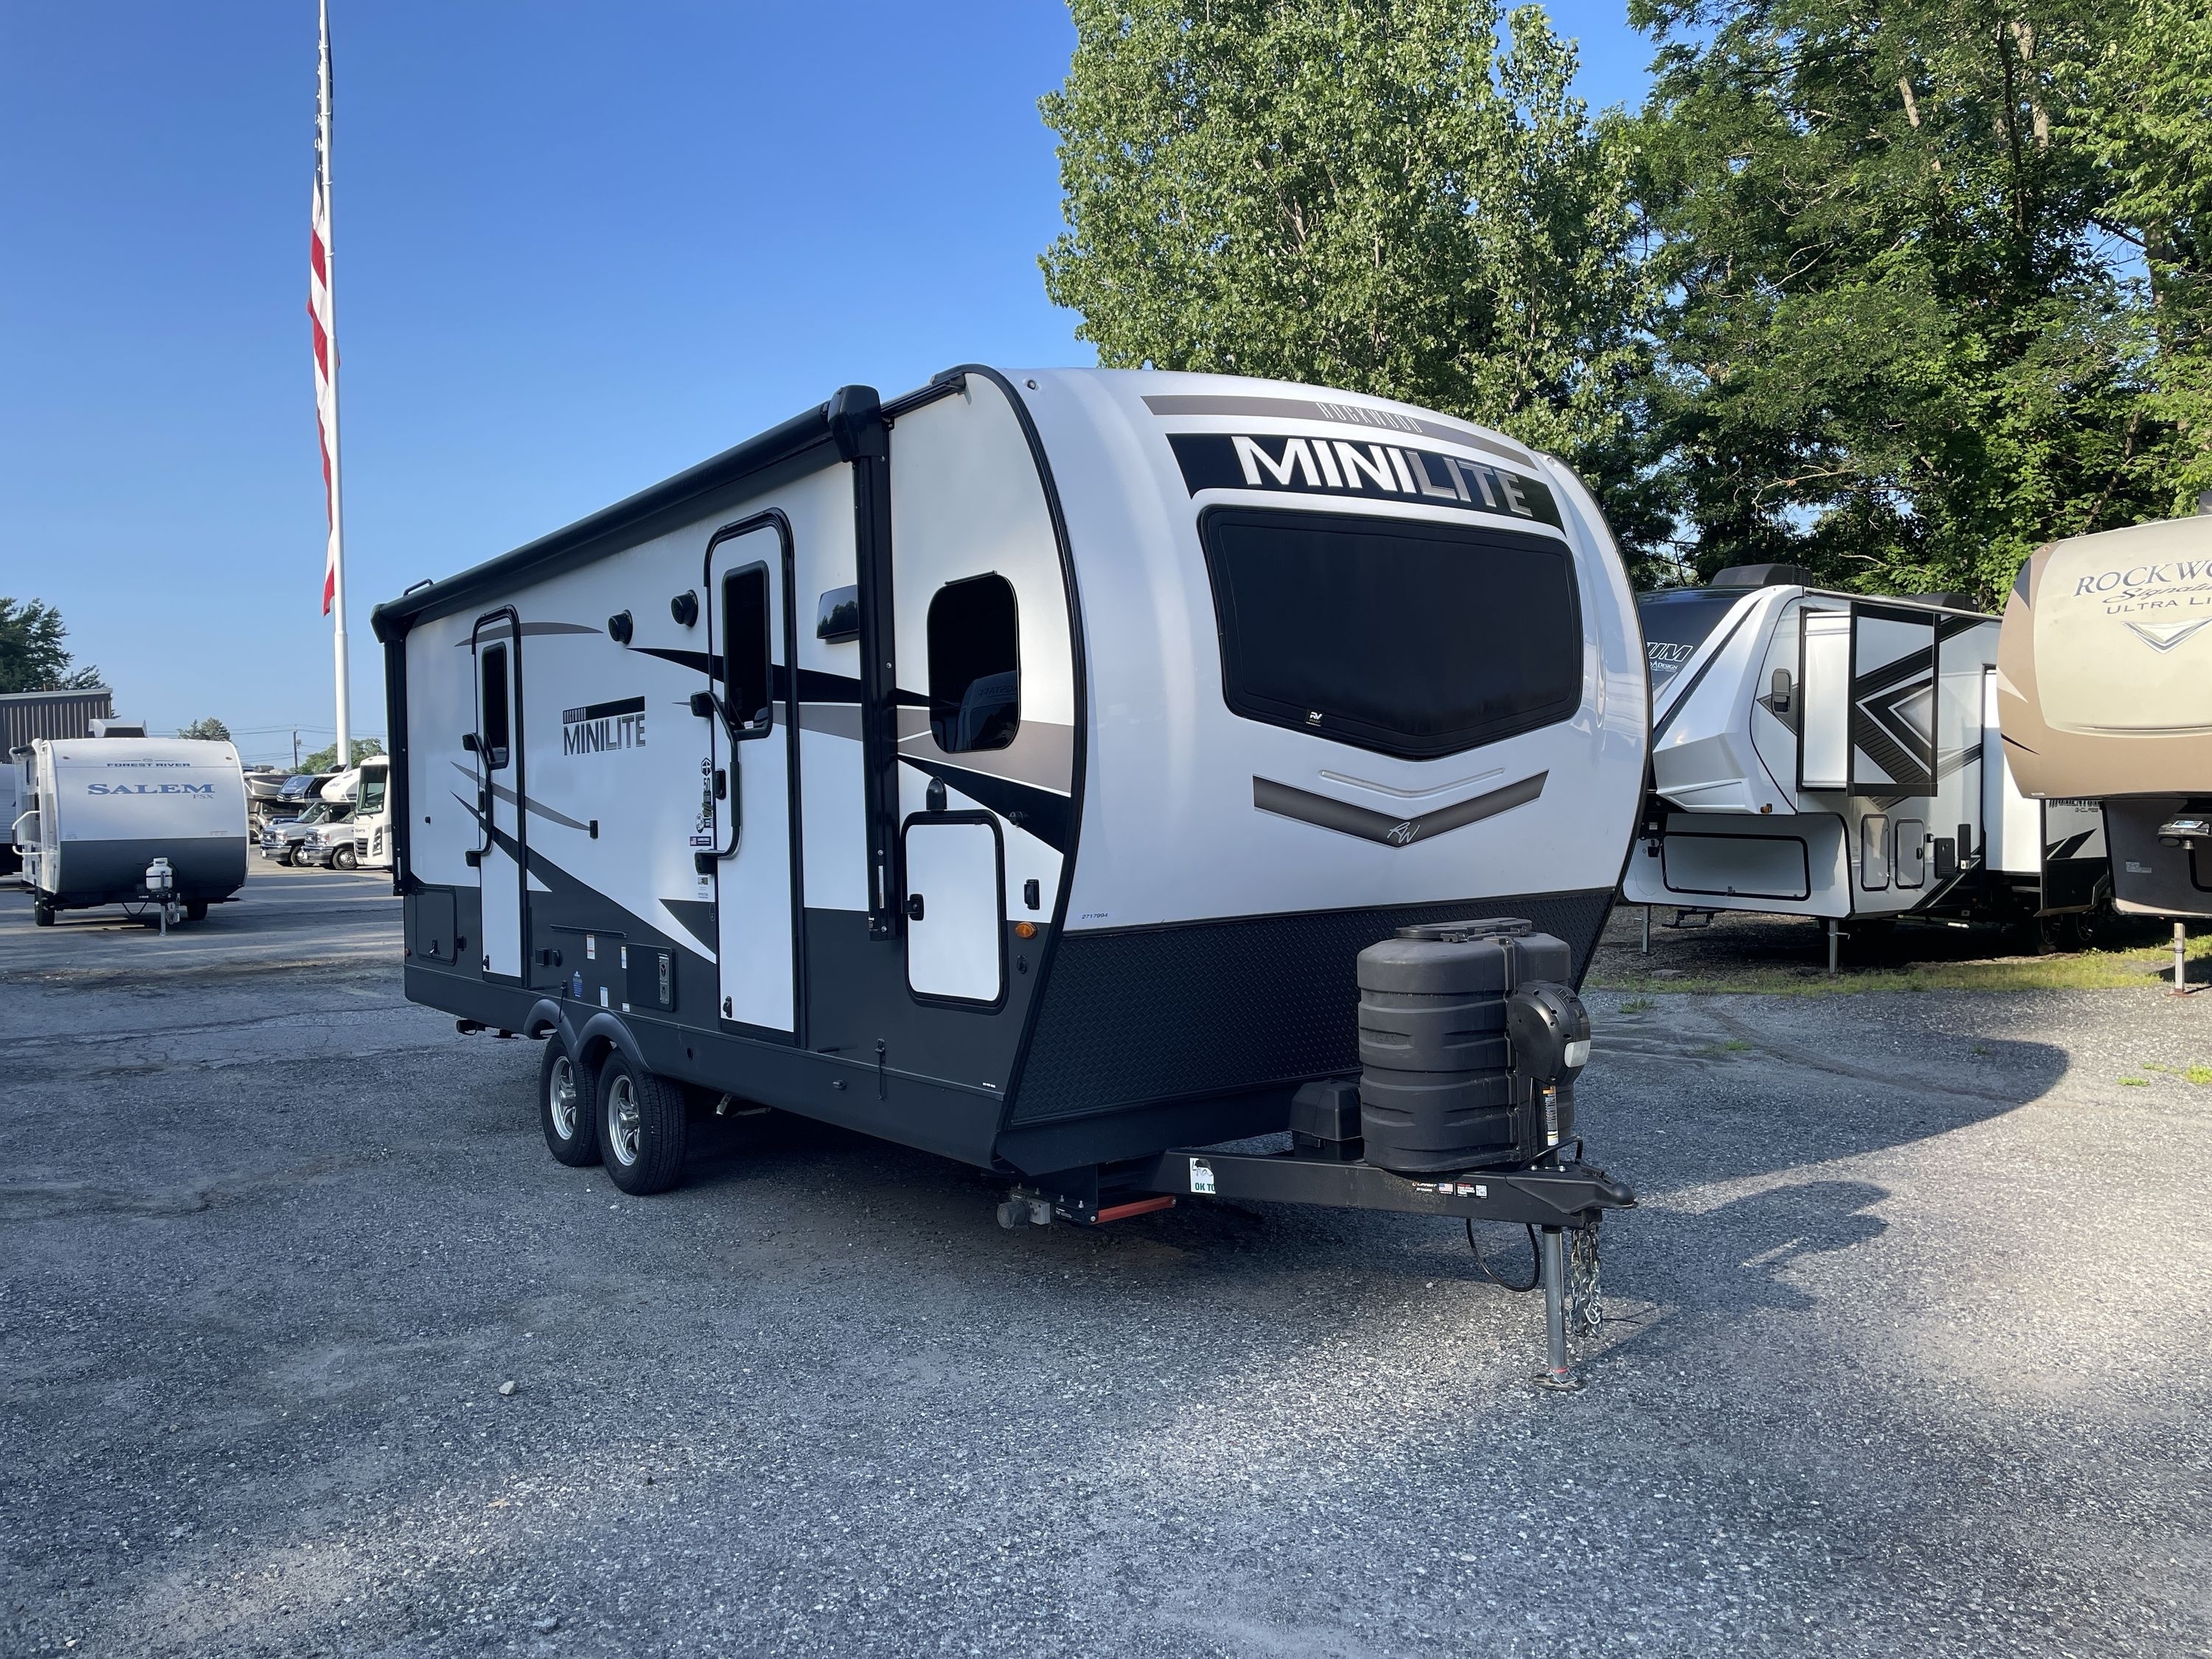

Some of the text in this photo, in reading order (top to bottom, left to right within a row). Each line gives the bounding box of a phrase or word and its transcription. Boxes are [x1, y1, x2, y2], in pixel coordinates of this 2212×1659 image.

[1315, 402, 1423, 433] ROCKWOOD
[1231, 436, 1533, 518] MINILITE
[2107, 599, 2179, 614] ULTRA
[1310, 712, 1323, 720] RV
[563, 713, 646, 756] MINILITE
[87, 783, 215, 796] SALEM
[1194, 1182, 1206, 1192] OK
